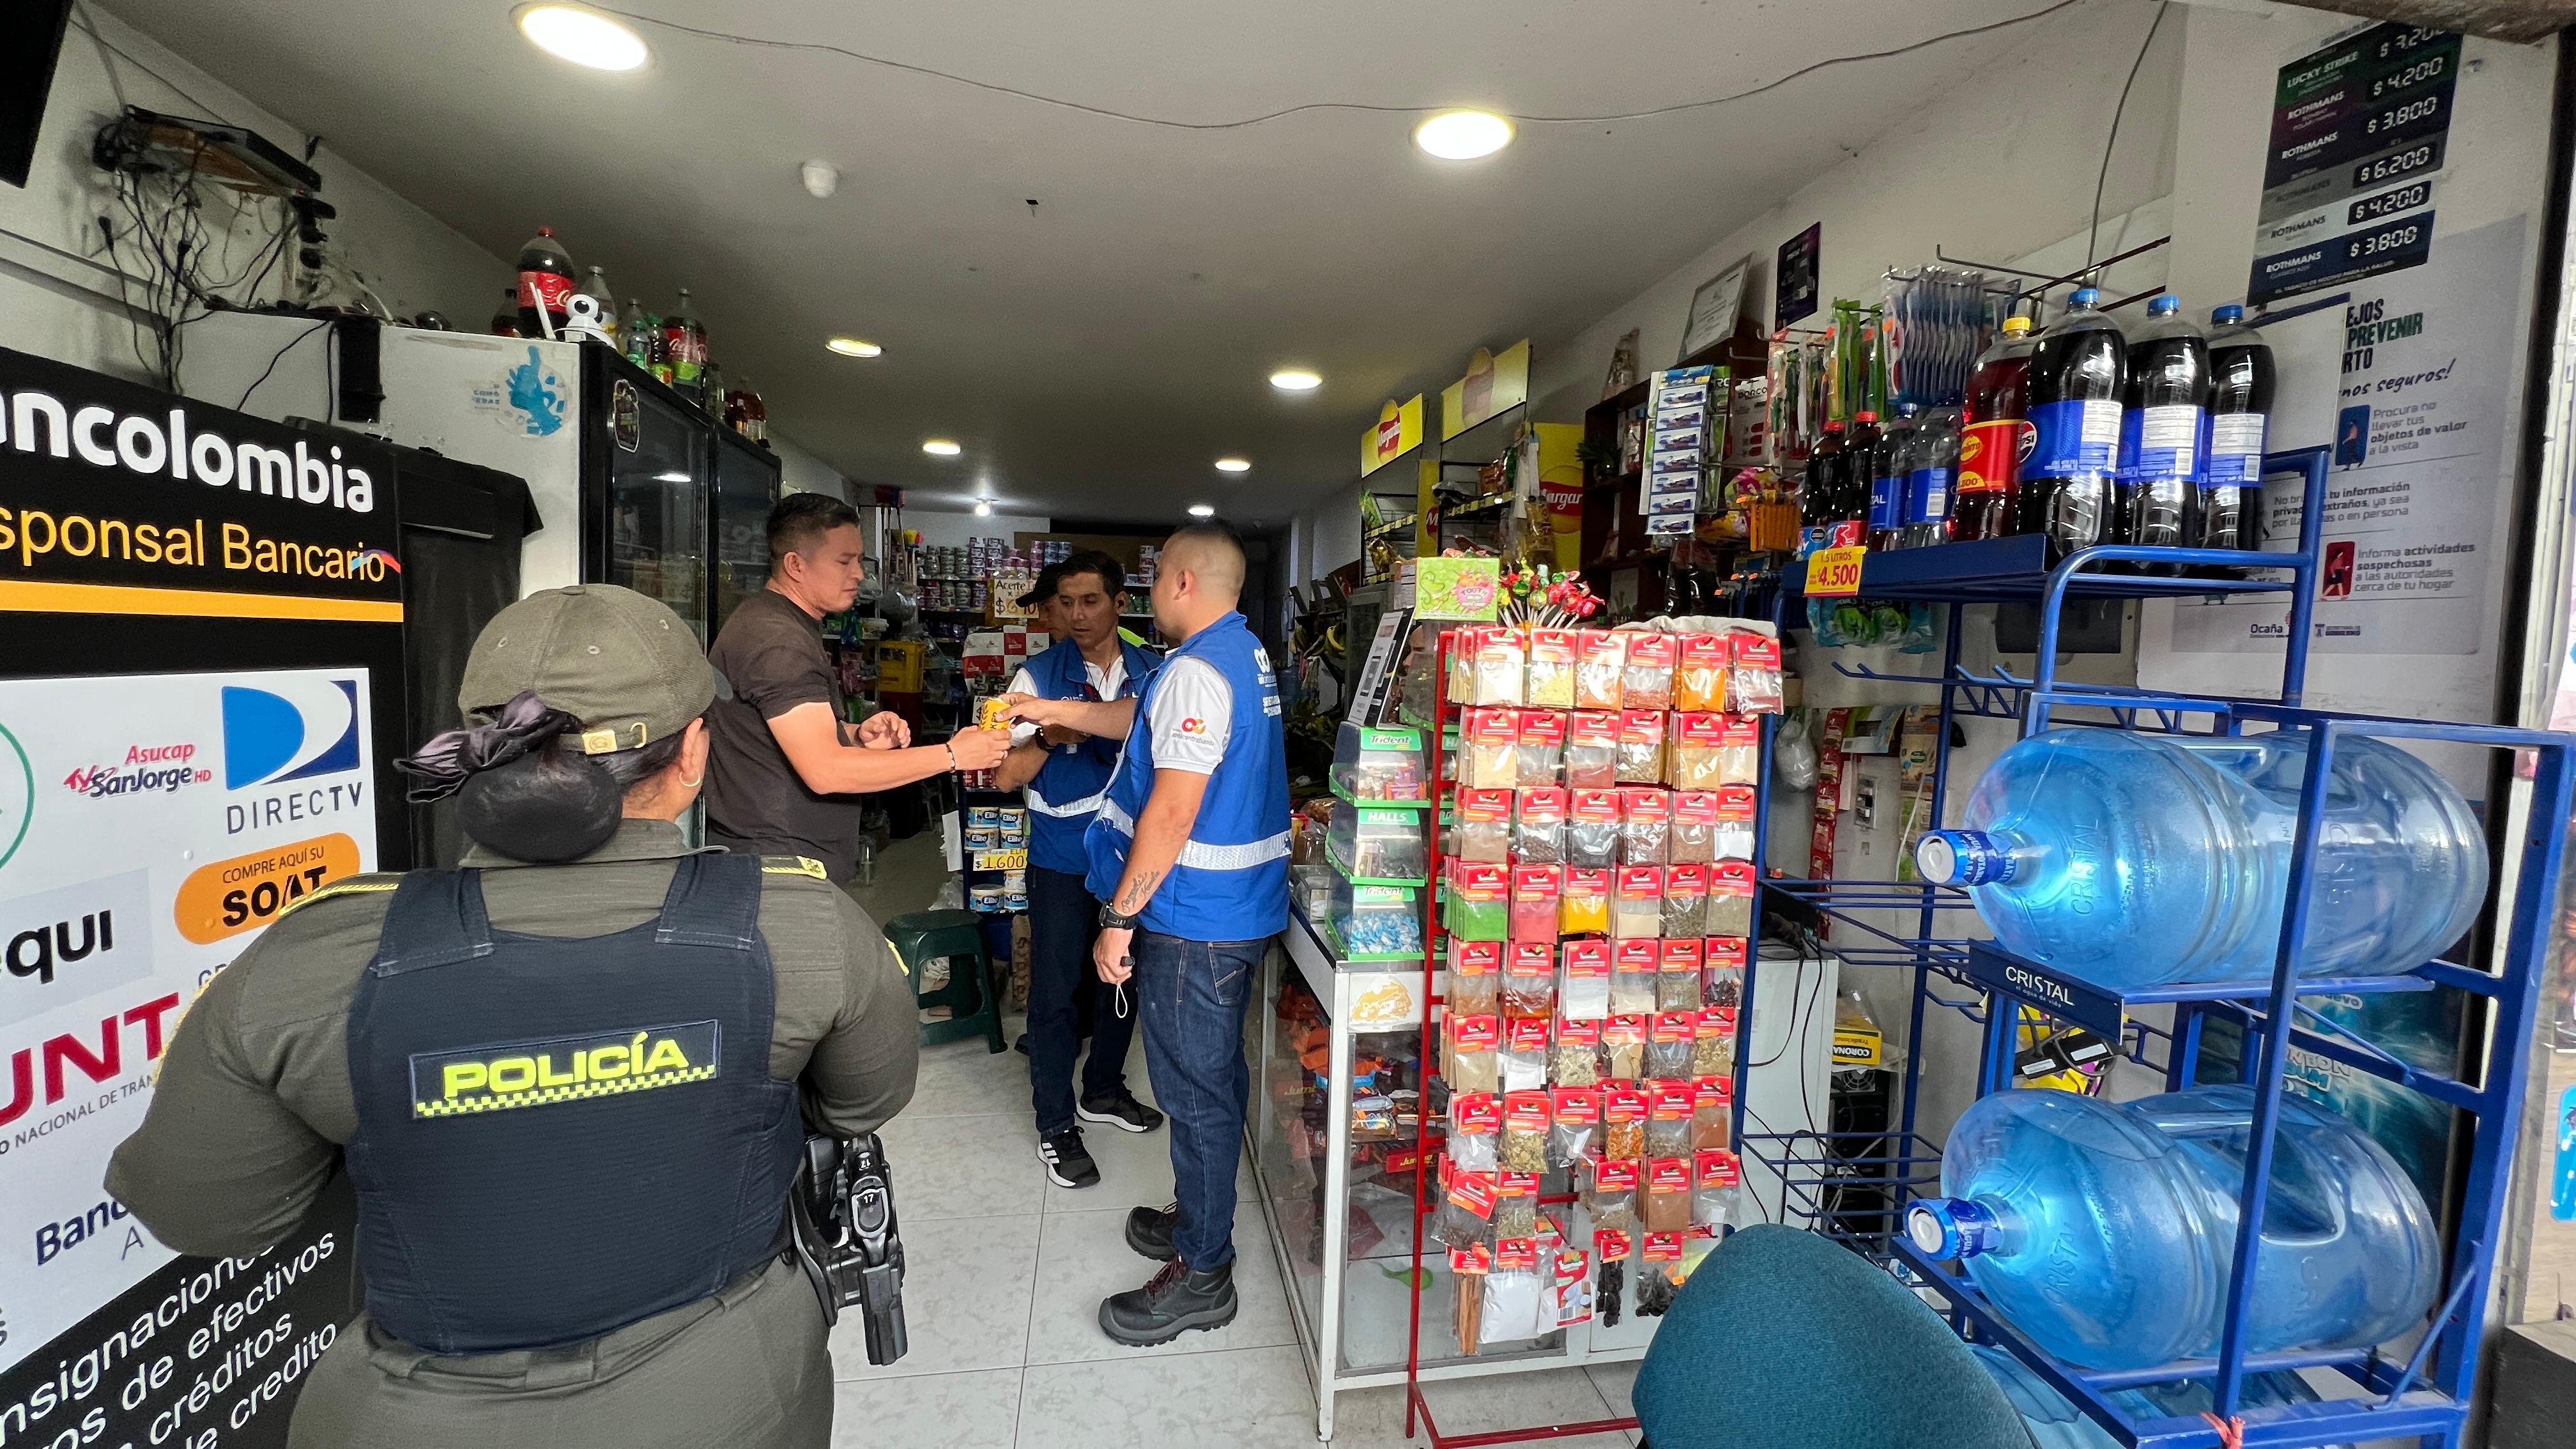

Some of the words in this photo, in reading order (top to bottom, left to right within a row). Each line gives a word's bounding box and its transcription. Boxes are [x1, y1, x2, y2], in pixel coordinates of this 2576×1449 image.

[2287, 66, 2322, 88] LUCKY
[2324, 51, 2360, 72] STRIKE
[2287, 90, 2345, 120] ROTHMANS
[2382, 96, 2437, 130] 3.800
[2281, 132, 2338, 159] ROTHMANS
[2373, 146, 2430, 179] 6.200
[2271, 215, 2326, 238] ROTHMANS
[2365, 226, 2418, 256] 3.800
[2266, 251, 2321, 273] ROTHMANS
[2346, 298, 2384, 328] EJOS
[2347, 312, 2423, 349] PREVENIR
[2342, 348, 2373, 374] RTO
[2377, 358, 2456, 393] seguros!
[1738, 387, 1768, 399] DORCO
[2372, 419, 2402, 431] llevar
[2407, 416, 2425, 425] tus
[2373, 404, 2418, 420] Procura
[2421, 402, 2437, 411] no
[2370, 429, 2413, 443] objetos
[2417, 426, 2432, 436] de
[2434, 421, 2467, 433] valor
[0, 392, 374, 512] ncolombia
[2368, 447, 2375, 456] a
[2379, 444, 2389, 454] la
[2391, 441, 2419, 452] vista
[1539, 489, 1583, 510] argar
[2274, 496, 2288, 505] No
[2329, 491, 2340, 499] tu
[2343, 482, 2410, 497] información
[2373, 498, 2386, 509] ya
[2389, 495, 2409, 504] sea
[2272, 518, 2288, 528] por
[2363, 507, 2409, 521] persona
[0, 509, 204, 566] sponsal
[223, 523, 385, 582] Bancario
[1831, 551, 1851, 562] LITROS
[2358, 549, 2401, 558] Informa
[2404, 543, 2475, 556] actividades
[2357, 558, 2432, 572] sospechosas
[2365, 572, 2380, 581] las
[2384, 569, 2453, 579] autoridades
[2354, 582, 2384, 592] cerca
[2387, 581, 2401, 590] de
[2404, 581, 2416, 590] tu
[2418, 579, 2455, 592] hogar
[2251, 624, 2283, 634] Ocaña
[1370, 735, 1409, 744] Trident
[125, 744, 195, 765] Asucap
[90, 767, 192, 797] SanJorge
[195, 769, 211, 783] HD
[227, 781, 362, 834] DIRECTV
[1368, 812, 1407, 822] HALLS
[223, 858, 276, 884] COMPRE
[279, 847, 308, 870] AQUÍ
[310, 846, 325, 859] SU
[223, 866, 327, 927] SOAT
[1365, 886, 1402, 895] Trident
[2005, 966, 2076, 1006] CRISTAL
[0, 992, 180, 1128] UNT
[1833, 1046, 1870, 1057] CORONA
[443, 1031, 689, 1100] POLICÍA
[15, 1101, 96, 1148] NACIONAL
[100, 1089, 118, 1109] DE
[863, 1193, 874, 1204] 17
[36, 1200, 131, 1266] Banc
[122, 1354, 174, 1411] de
[188, 1232, 335, 1360] efectivos
[0, 1245, 274, 1447] nsignacion
[150, 1313, 293, 1445] créditos
[231, 1322, 337, 1430] credito
